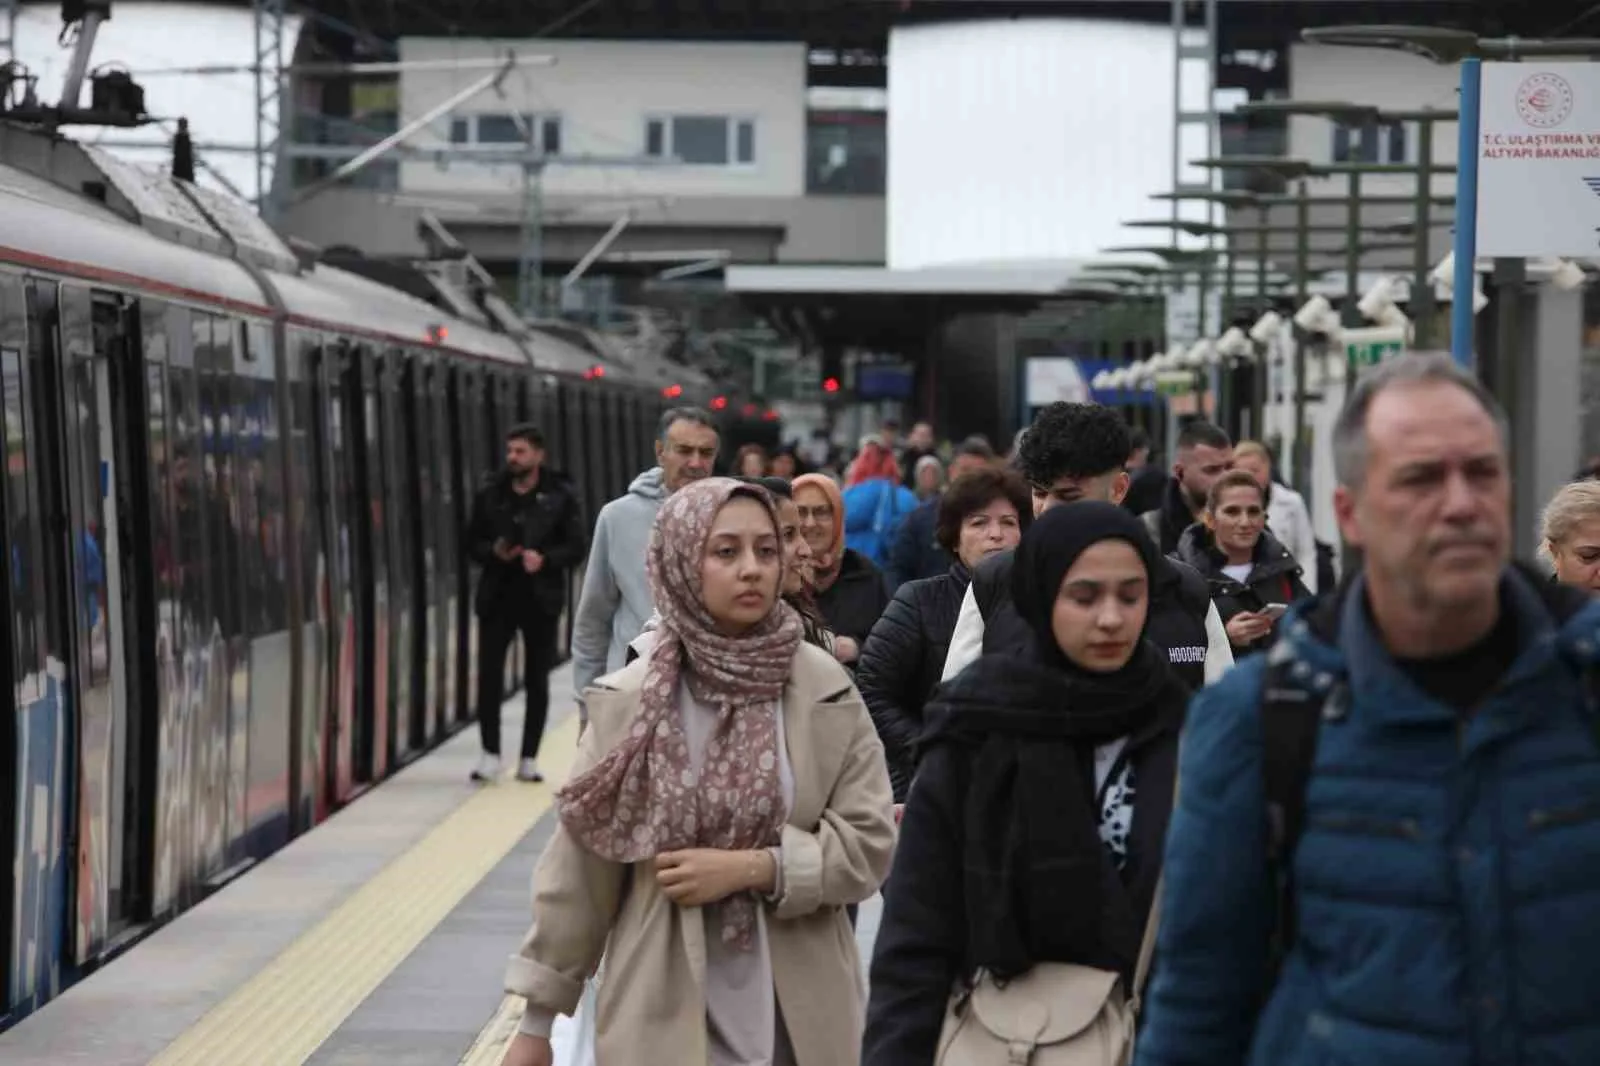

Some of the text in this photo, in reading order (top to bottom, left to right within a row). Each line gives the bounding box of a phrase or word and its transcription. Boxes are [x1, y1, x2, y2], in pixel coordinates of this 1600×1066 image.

[1484, 134, 1507, 145] T.C.
[1508, 134, 1584, 146] ULAŞTIRMA
[1484, 147, 1533, 158] ALTYAPI
